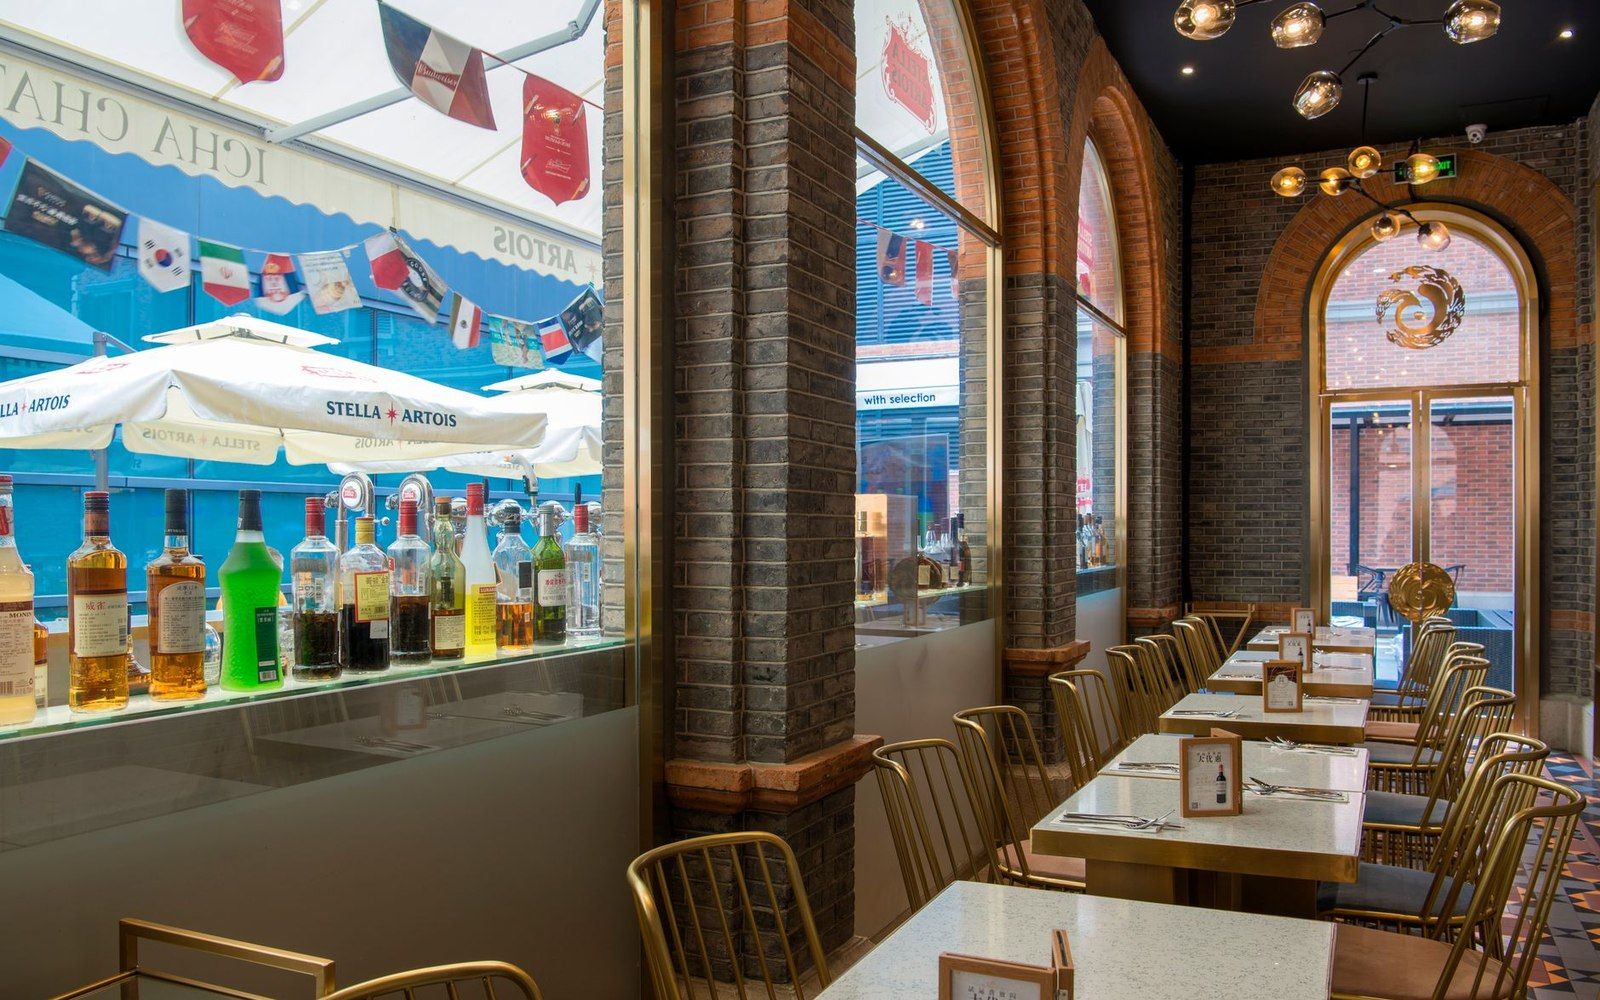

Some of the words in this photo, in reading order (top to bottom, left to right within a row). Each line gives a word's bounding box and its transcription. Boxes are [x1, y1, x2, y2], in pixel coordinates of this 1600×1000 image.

[28, 395, 71, 413] ARTOIS
[864, 394, 886, 405] with
[889, 393, 936, 405] selection
[326, 401, 381, 420] STELLA
[401, 409, 457, 427] ARTOIS
